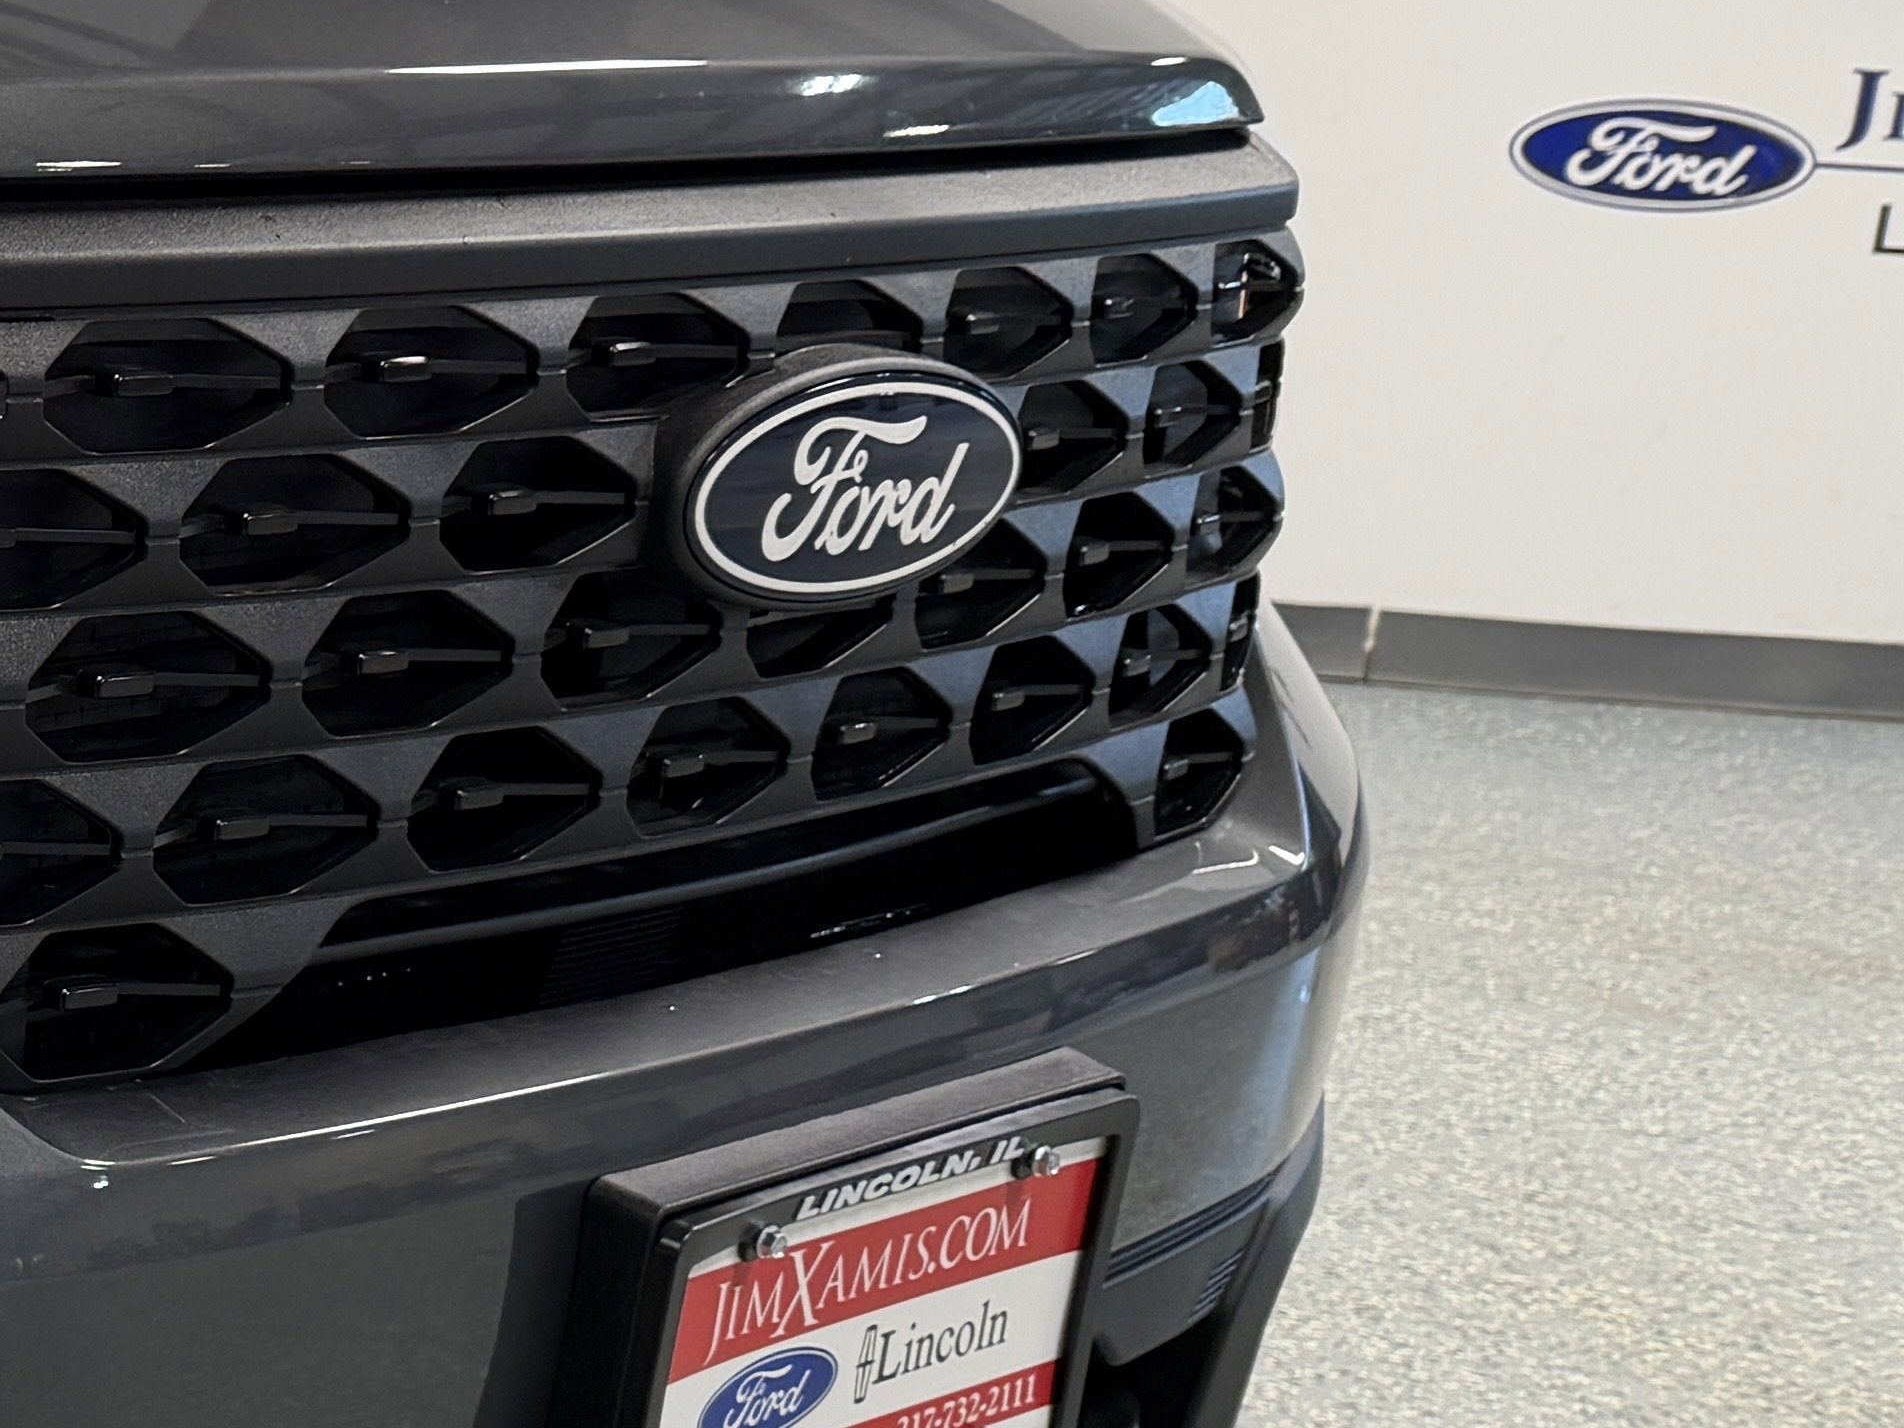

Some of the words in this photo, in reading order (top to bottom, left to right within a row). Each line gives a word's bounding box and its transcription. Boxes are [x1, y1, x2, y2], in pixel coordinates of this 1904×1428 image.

[1566, 116, 1758, 196] Ford
[761, 415, 970, 562] Ford
[991, 1135, 1025, 1165] IL
[702, 1197, 1031, 1367] JIMXAMIS.COM
[872, 1299, 1008, 1384] Lincoln
